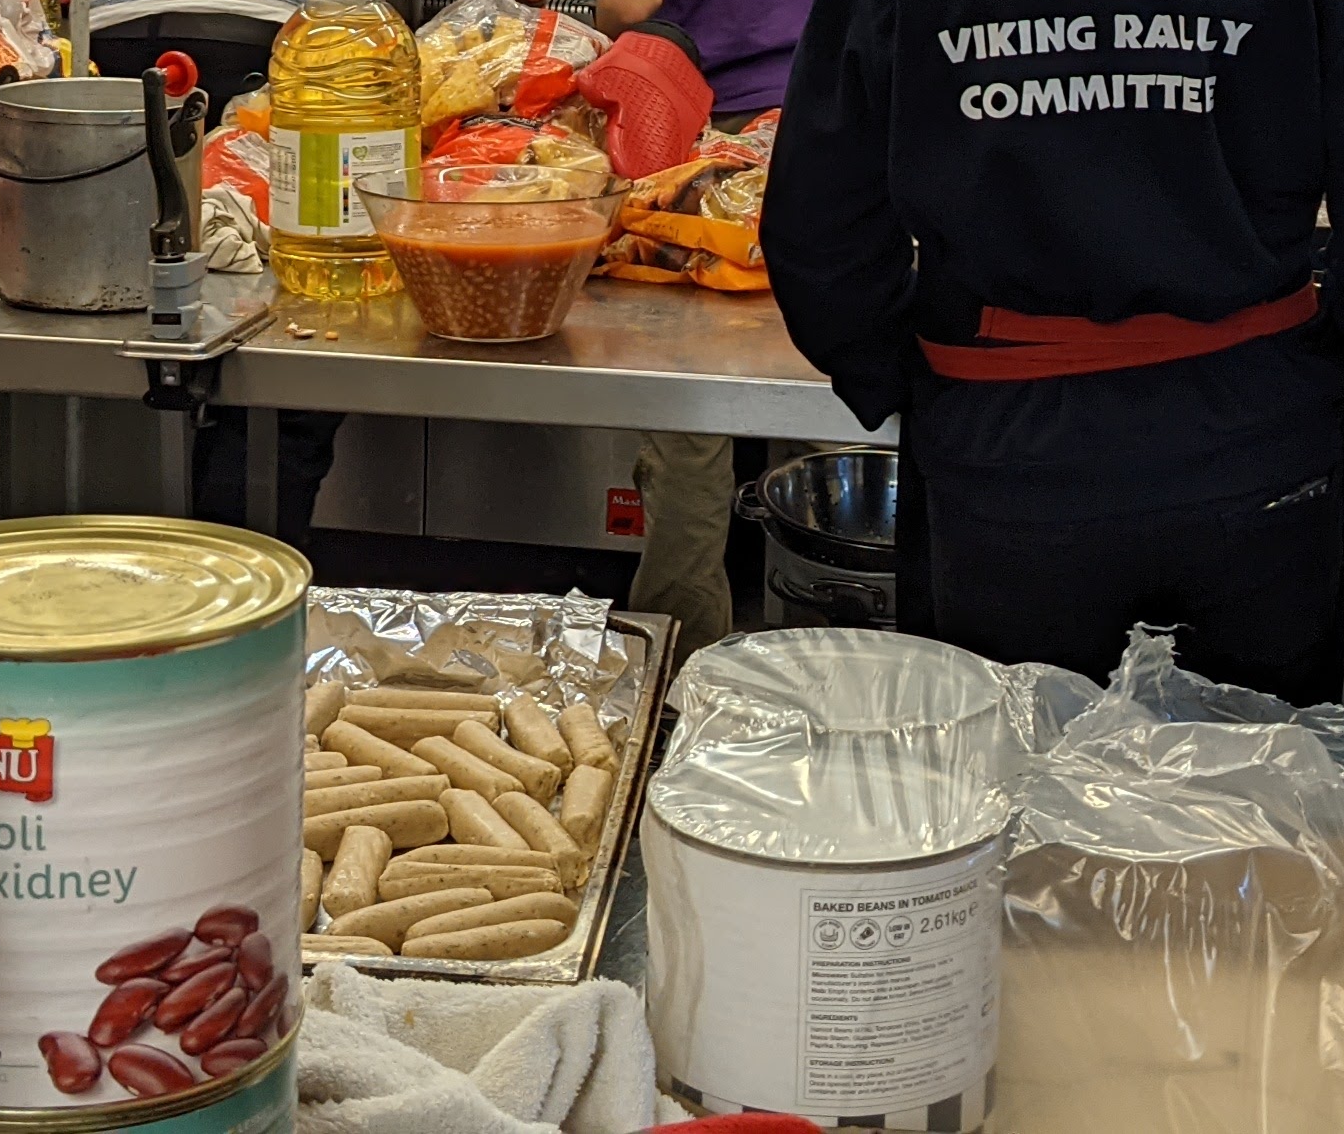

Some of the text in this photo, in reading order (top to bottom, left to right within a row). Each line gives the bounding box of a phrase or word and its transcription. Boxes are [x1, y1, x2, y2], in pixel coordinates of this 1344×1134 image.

[938, 13, 1253, 64] VIKING RALLY
[959, 73, 1218, 121] COMMITTEE
[813, 879, 979, 913] BAKED BEANS IN TOMATO SAUCE
[919, 907, 967, 934] 2.61kg
